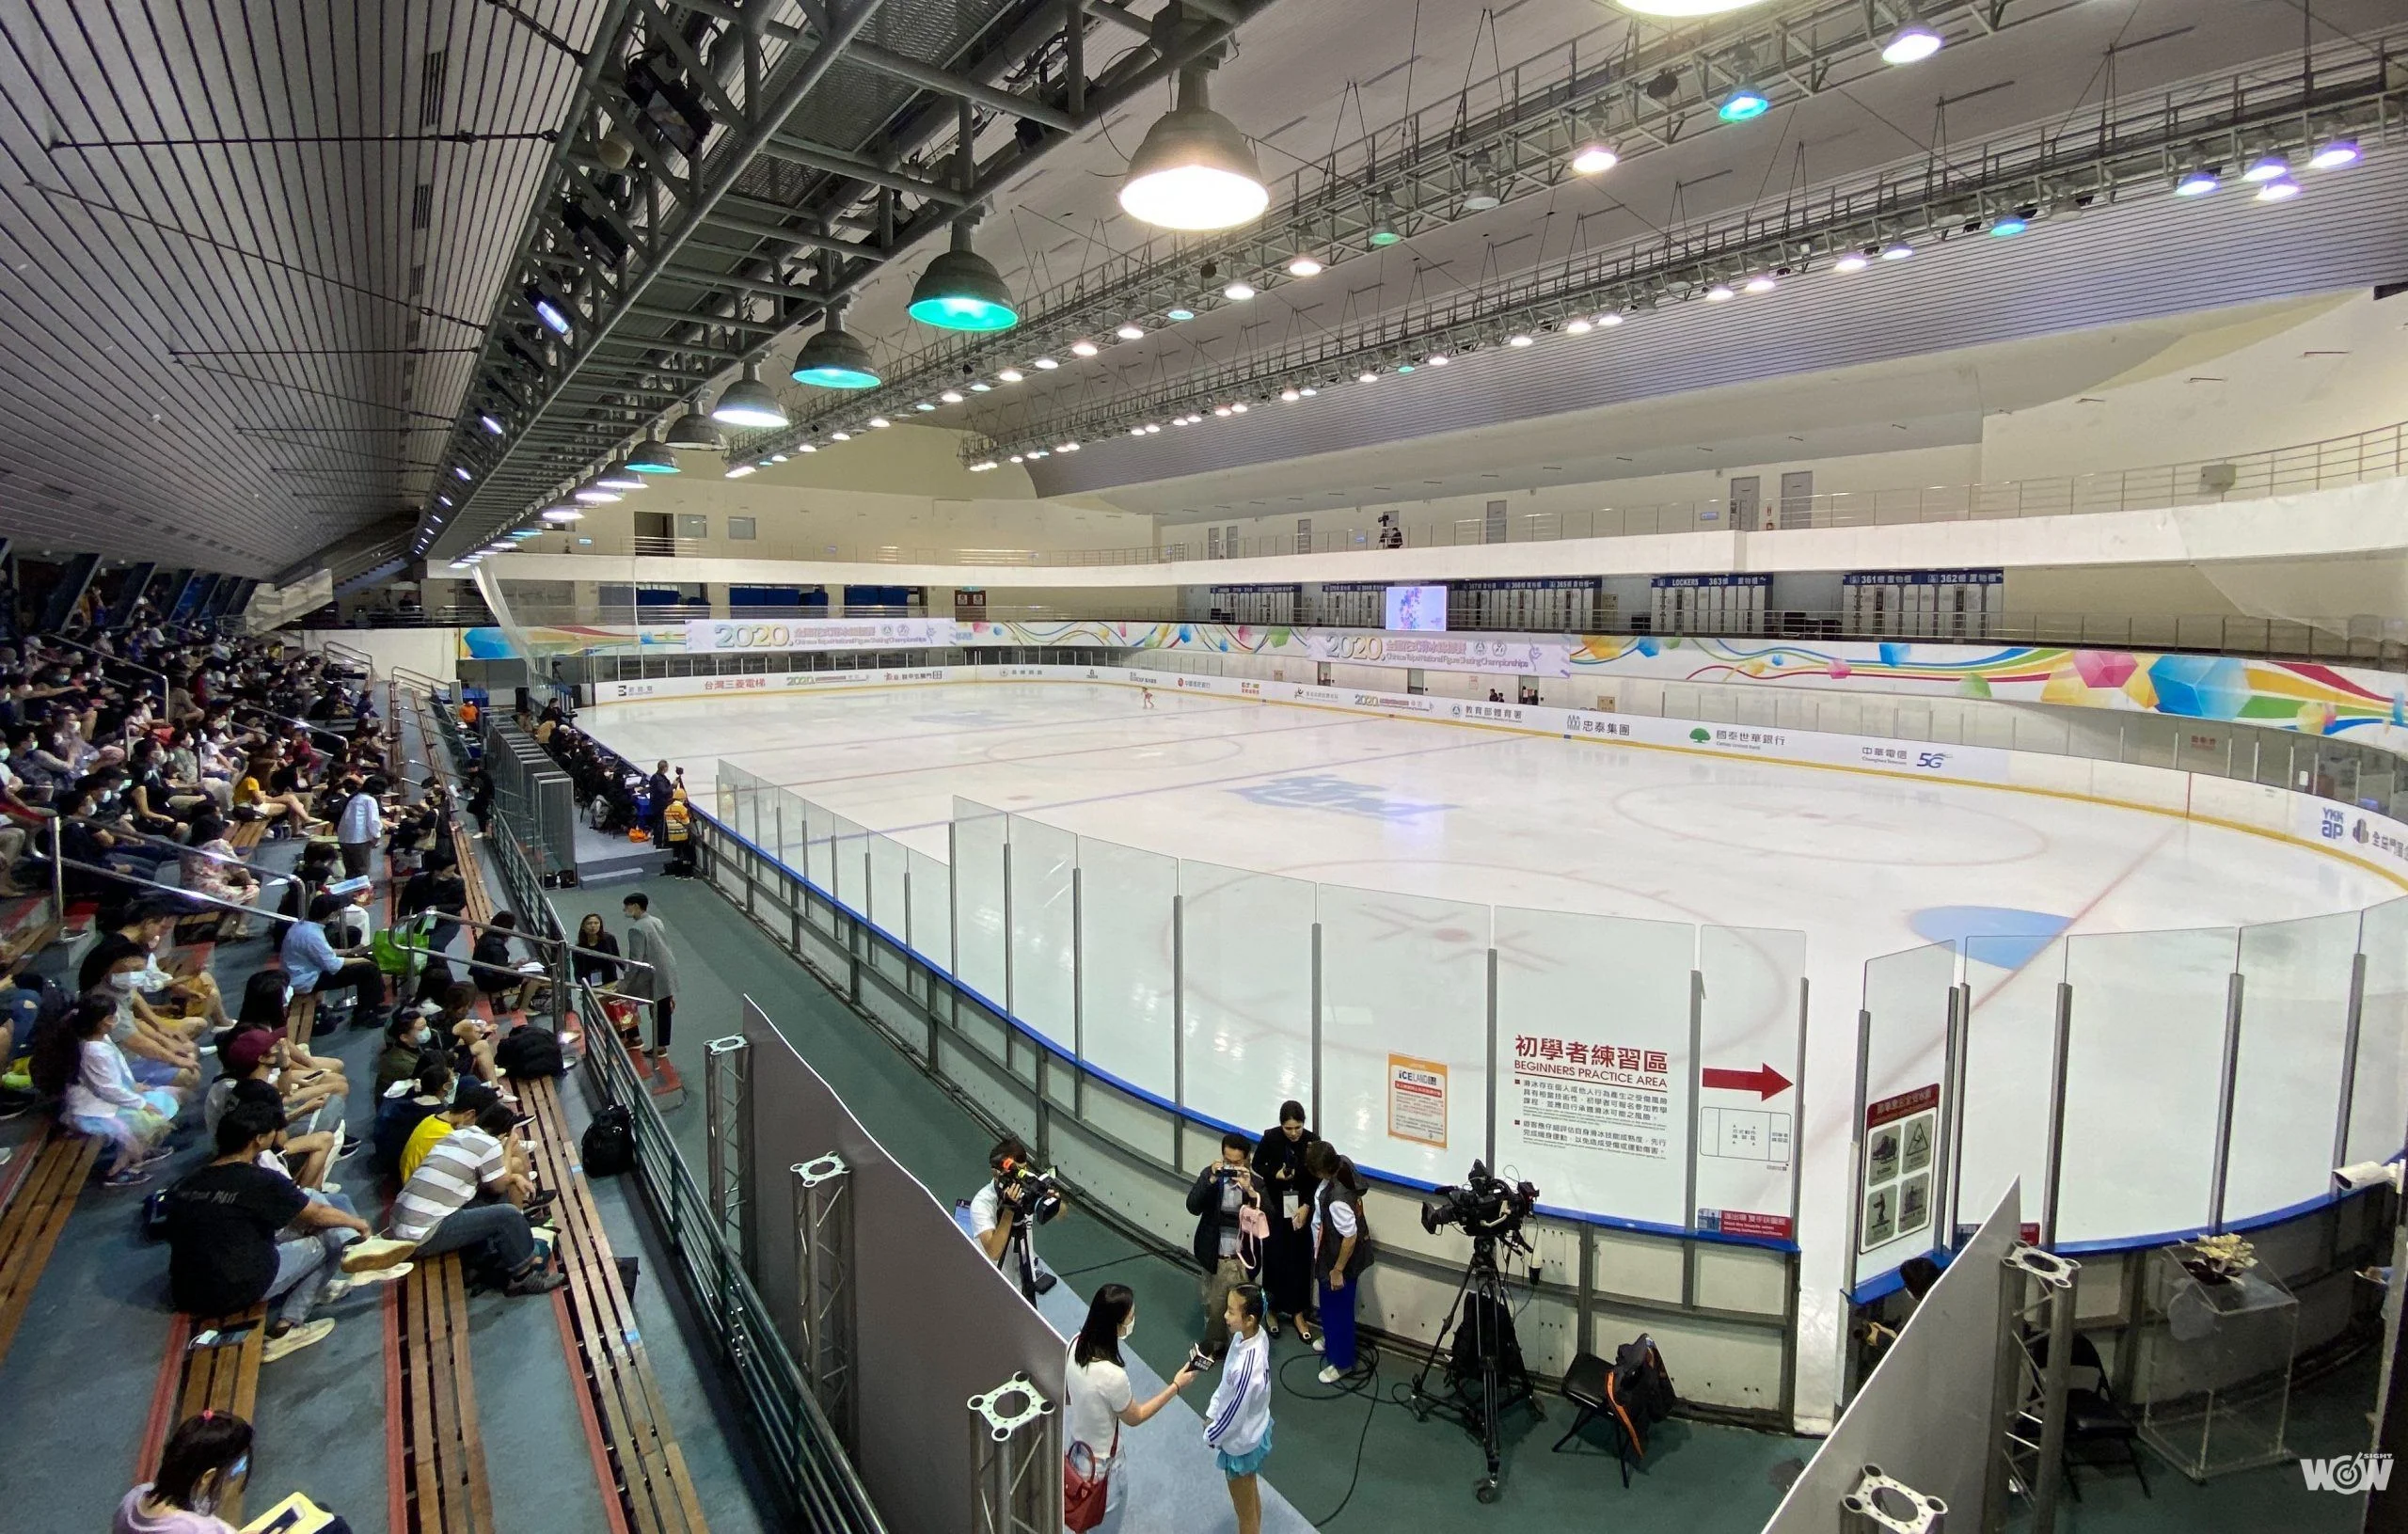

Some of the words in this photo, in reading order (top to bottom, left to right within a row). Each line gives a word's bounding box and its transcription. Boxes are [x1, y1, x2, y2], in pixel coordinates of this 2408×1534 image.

[1671, 578, 1699, 587] LOCKERS
[705, 678, 766, 690] 台灣三菱電梯
[1465, 705, 1522, 720] 教育部體育署
[1583, 720, 1630, 735] 忠泰集團
[1717, 730, 1785, 746] 國泰世華銀行
[1862, 747, 1907, 759] 中華電信
[1917, 752, 1944, 768] 5G
[2322, 807, 2344, 824] YKK
[2321, 820, 2344, 839] ap
[1515, 1035, 1668, 1073] 初學者練習區
[1514, 1059, 1575, 1076] BEGINNERS
[1578, 1067, 1633, 1083] PRACTICE
[1636, 1075, 1668, 1088] AREA
